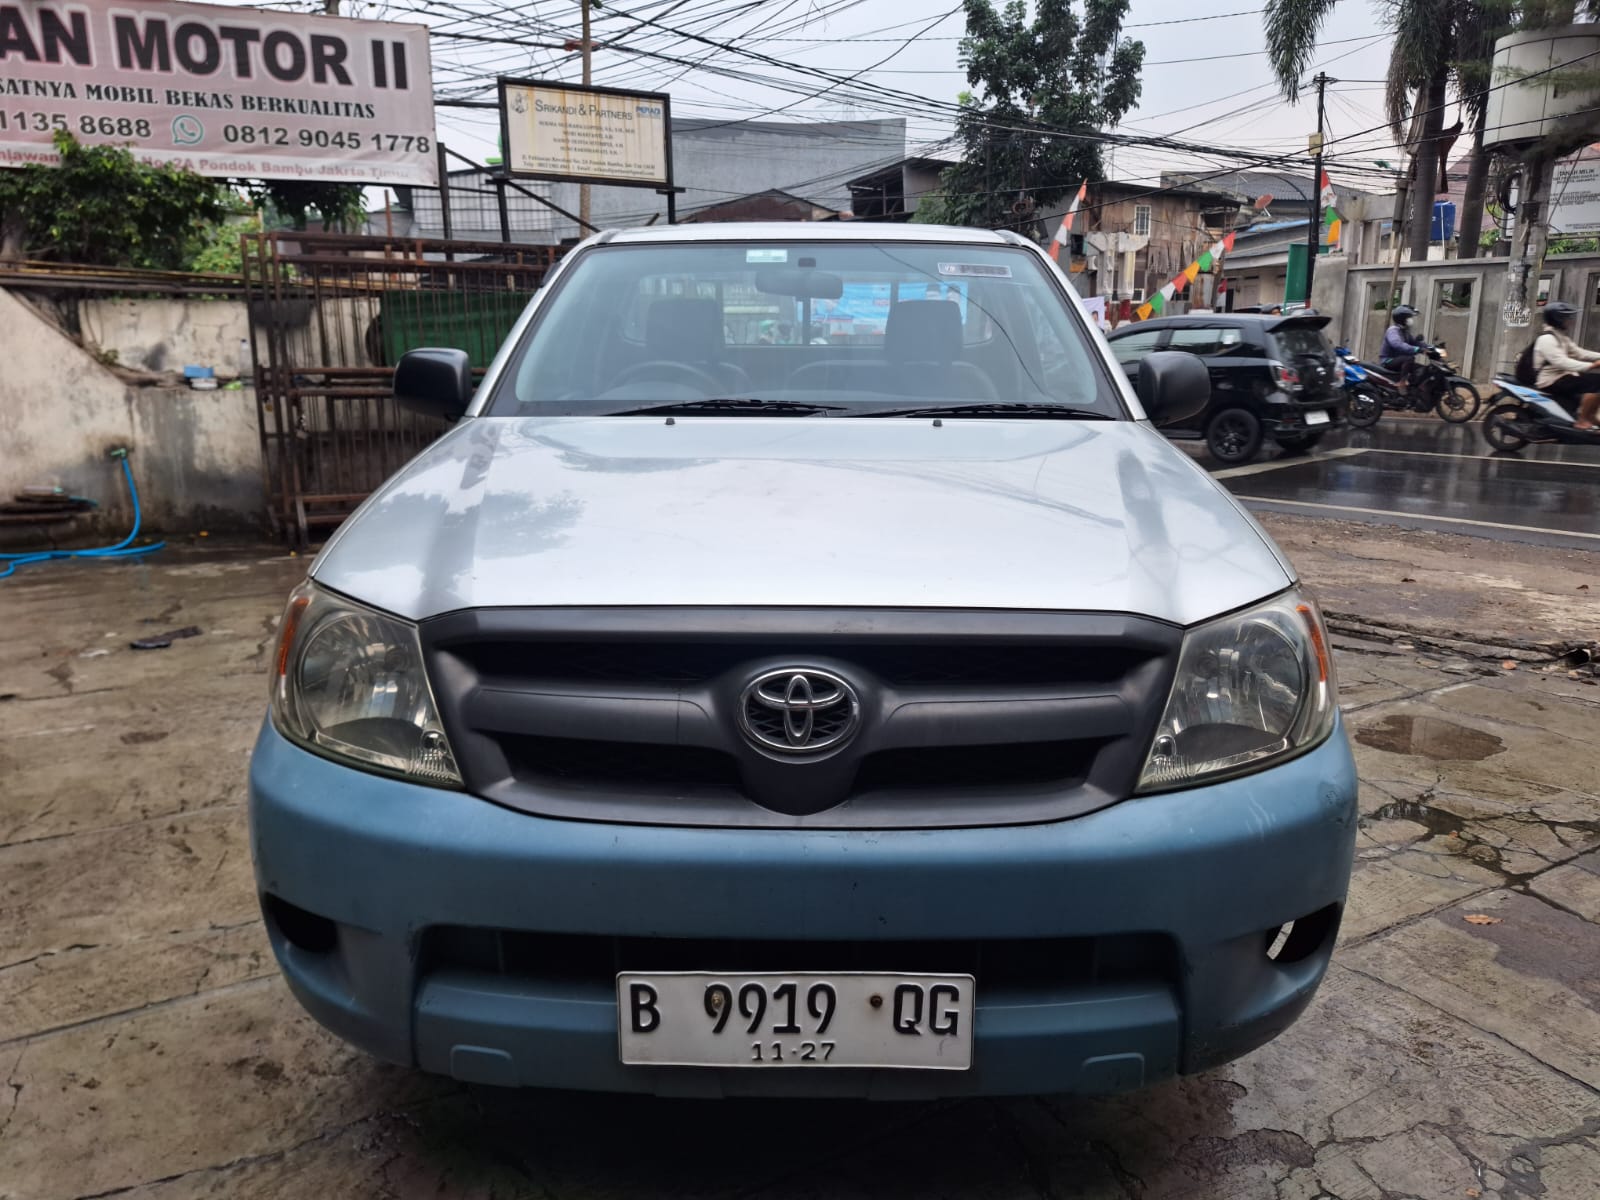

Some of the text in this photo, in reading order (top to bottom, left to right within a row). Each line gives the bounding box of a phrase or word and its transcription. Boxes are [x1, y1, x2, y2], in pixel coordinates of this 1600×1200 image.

[0, 5, 409, 90] AN MOTOR II
[86, 84, 157, 104] MOBIL
[166, 90, 233, 111] BEKAS
[241, 96, 375, 119] BERKUALITAS
[578, 104, 587, 116] &
[80, 115, 152, 138] 8688
[224, 124, 430, 153] 0812 9045 1778
[199, 159, 256, 172] Pondok
[261, 162, 313, 176] Bambu
[630, 983, 960, 1036] B 9919 QG
